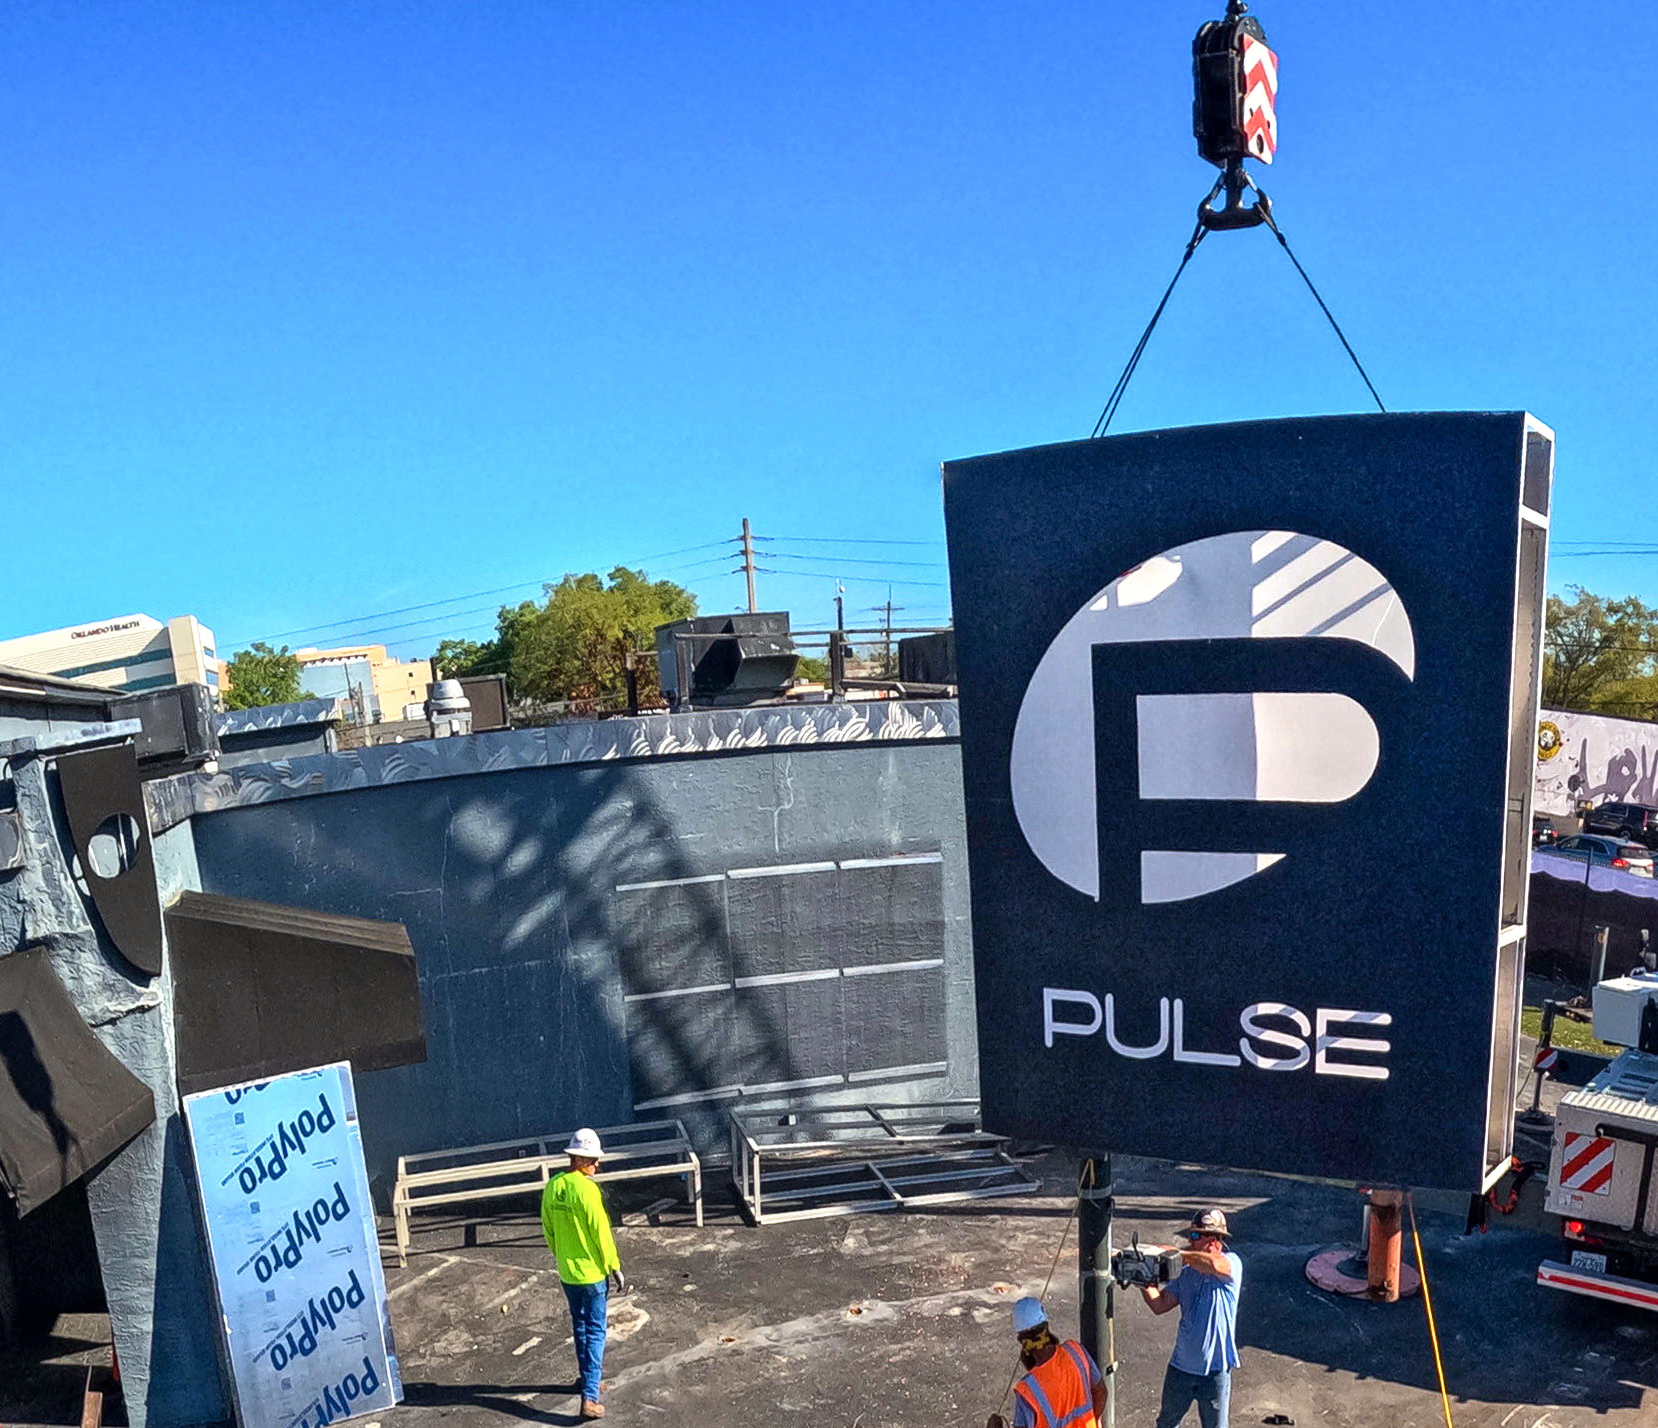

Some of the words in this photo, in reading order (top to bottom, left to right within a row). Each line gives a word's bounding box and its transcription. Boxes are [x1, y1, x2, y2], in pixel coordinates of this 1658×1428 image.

[1042, 986, 1393, 1080] PULSE
[238, 1092, 336, 1195] PolyPro
[253, 1181, 350, 1283] PolyPro
[270, 1268, 365, 1372] PolyPro
